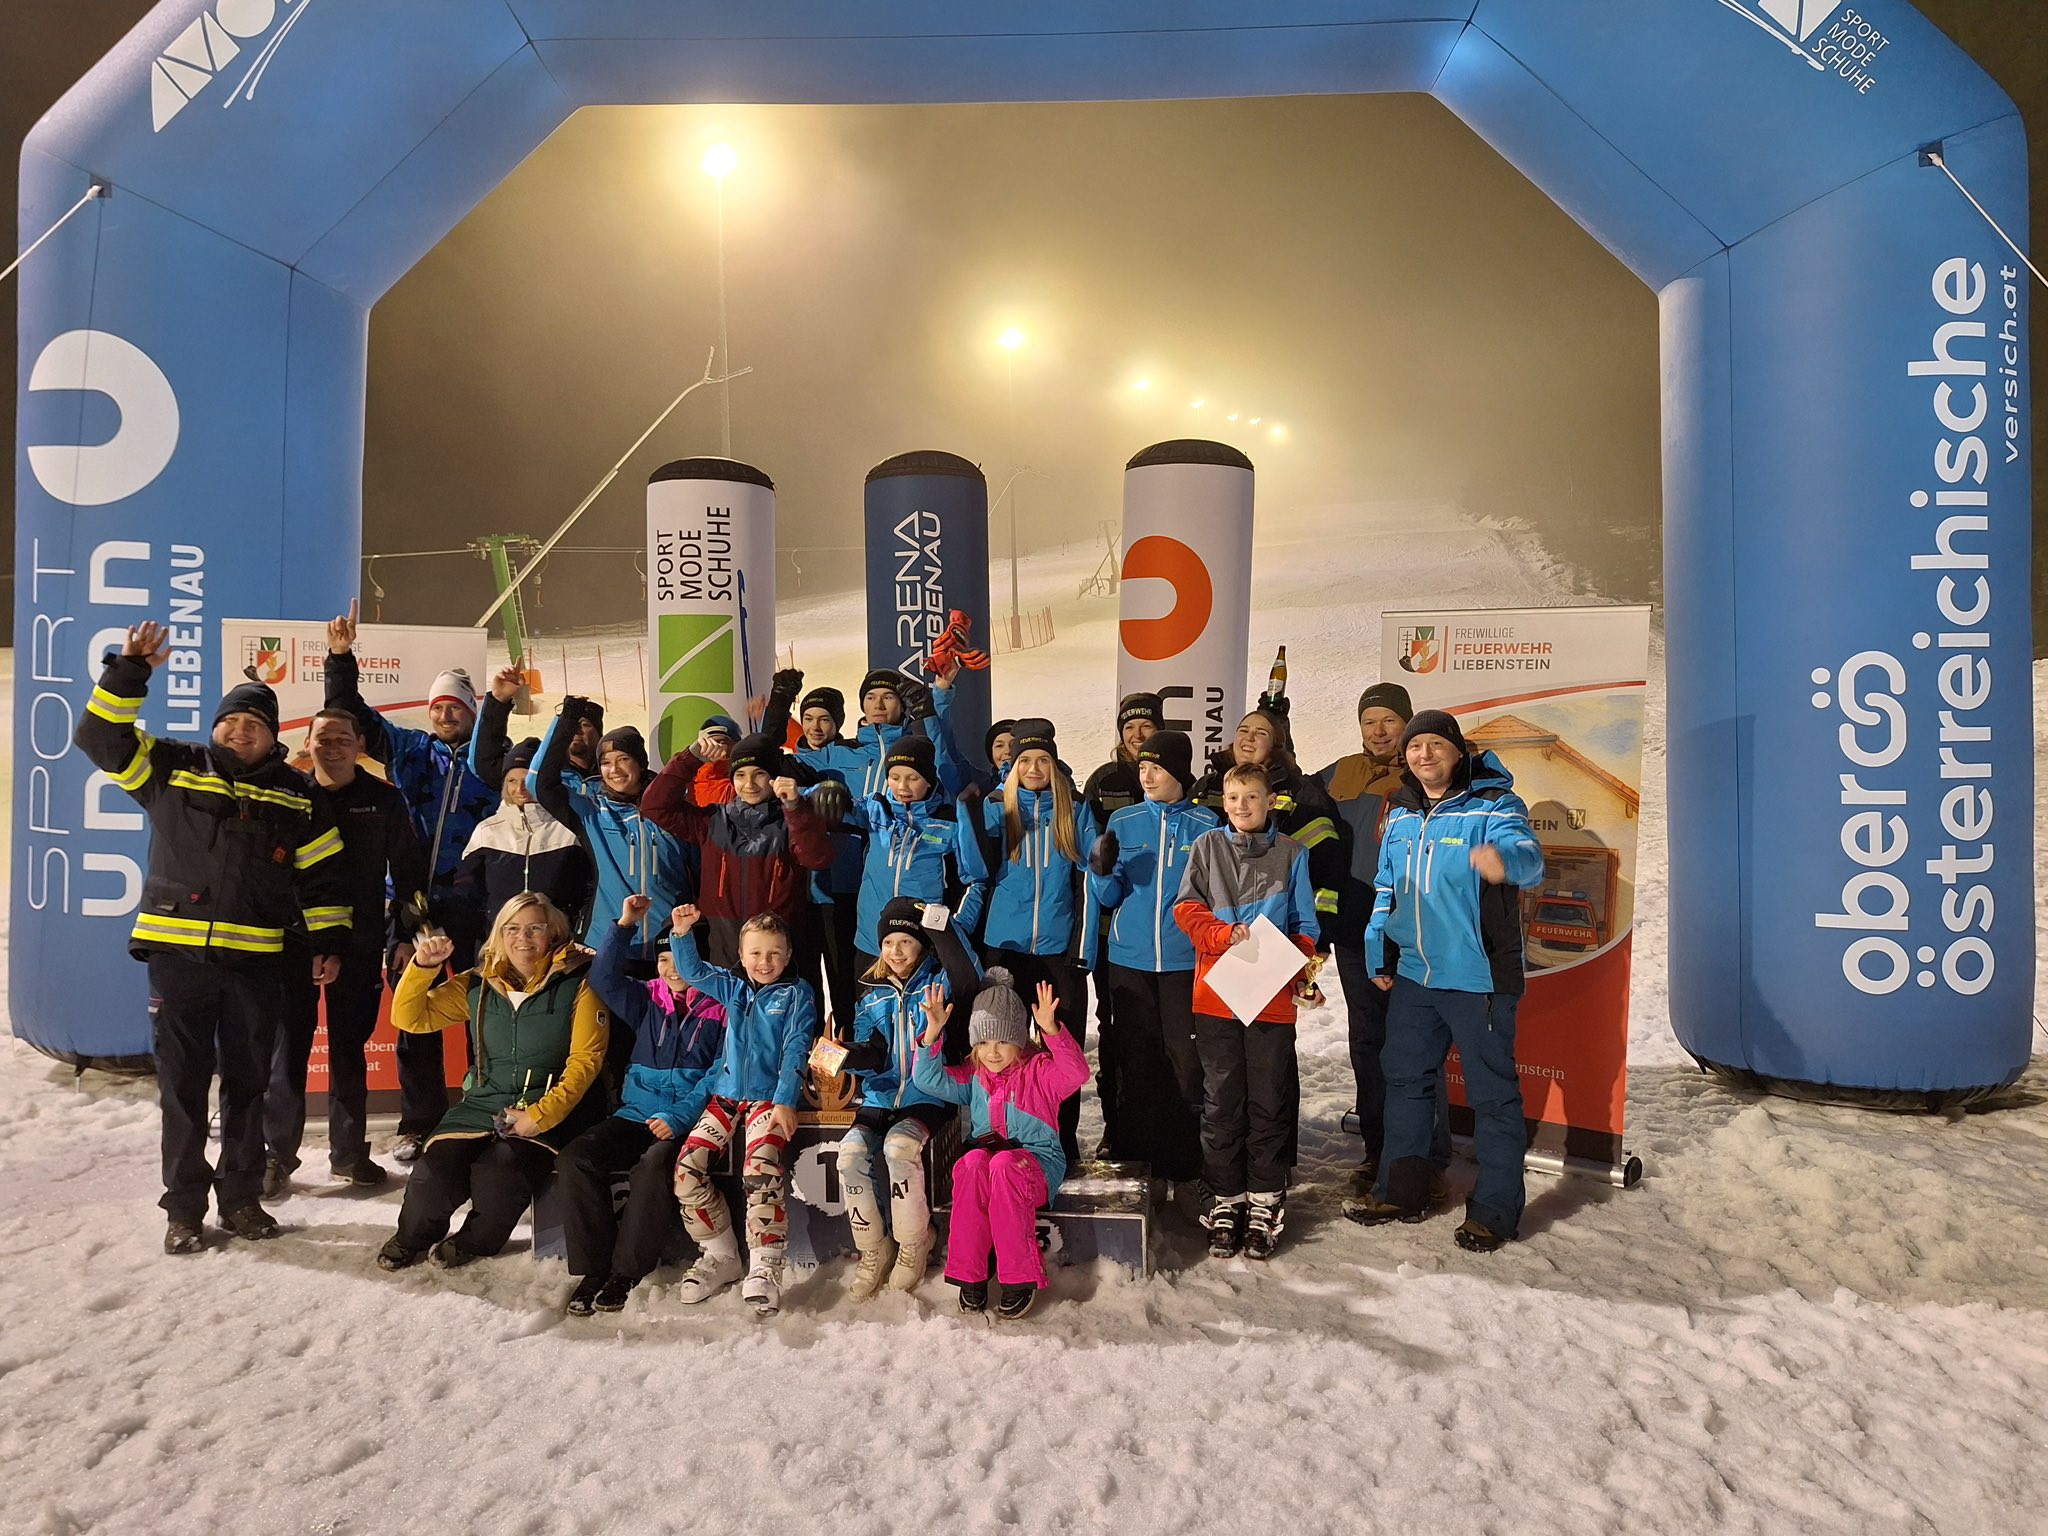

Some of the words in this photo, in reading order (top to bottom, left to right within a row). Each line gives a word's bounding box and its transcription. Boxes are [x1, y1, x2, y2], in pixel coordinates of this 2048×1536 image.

[1827, 23, 1876, 67] MODE
[1841, 9, 1890, 51] SPORT
[1812, 38, 1876, 95] SCHUHE
[1999, 264, 2019, 464] versich.at
[657, 529, 674, 601] SPORT
[679, 529, 702, 601] MODE
[707, 506, 731, 601] SCHUHE
[894, 510, 925, 685] ARENA
[167, 544, 206, 732] LIEBENAU
[1454, 642, 1552, 655] FEUERWEHR
[1455, 627, 1515, 639] FREIWILLIGE
[1908, 257, 1995, 995] österreichische
[302, 655, 401, 669] FEWEHR
[302, 671, 400, 684] LIESTEIN
[1453, 658, 1551, 671] LIEBENSTEIN
[28, 538, 76, 914] SPORT
[1536, 927, 1592, 938] FEUERWEHR
[816, 1151, 840, 1203] 1
[892, 1179, 909, 1199] A1
